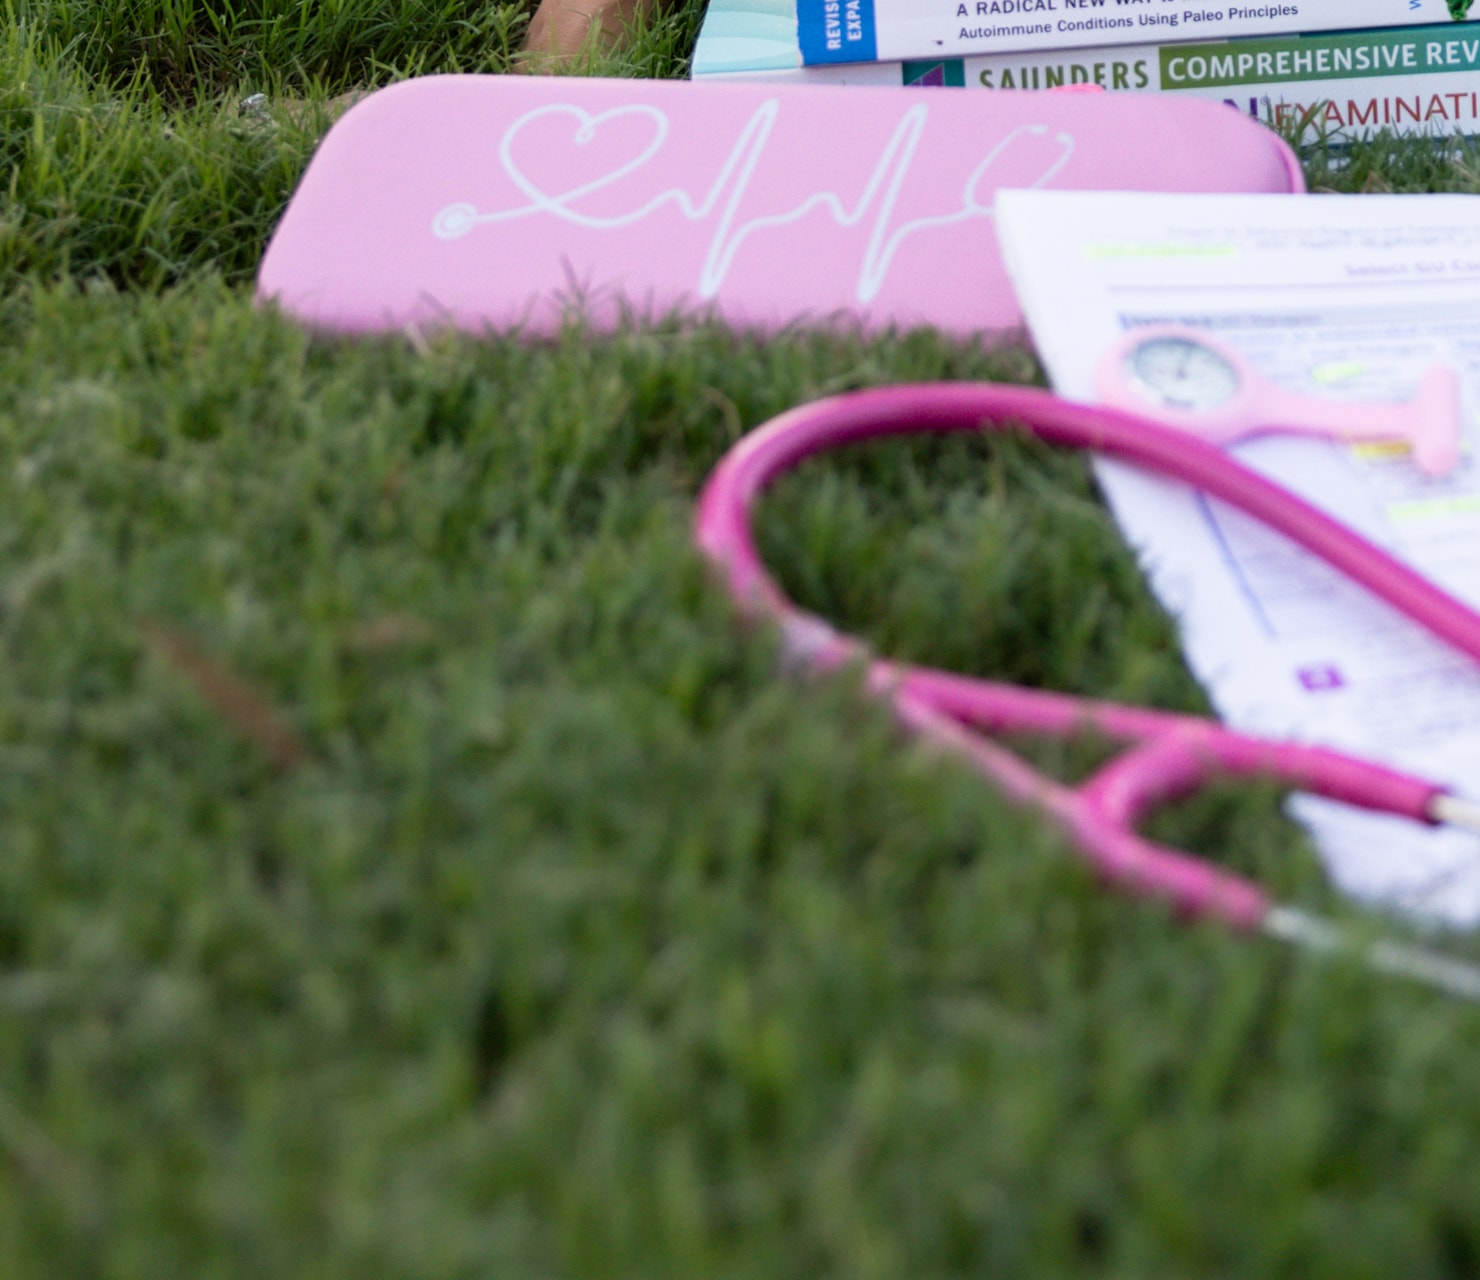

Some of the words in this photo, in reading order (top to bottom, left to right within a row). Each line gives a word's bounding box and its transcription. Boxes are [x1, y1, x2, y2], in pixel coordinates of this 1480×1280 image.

[956, 3, 969, 17] A
[959, 20, 1052, 39] Autoimmune
[1057, 14, 1134, 33] Conditions
[1138, 10, 1179, 29] Using
[1183, 6, 1224, 23] Paleo
[1227, 2, 1299, 23] Principles
[979, 60, 1149, 90] SAUNDERS
[1167, 44, 1417, 82] COMPREHENSIVE
